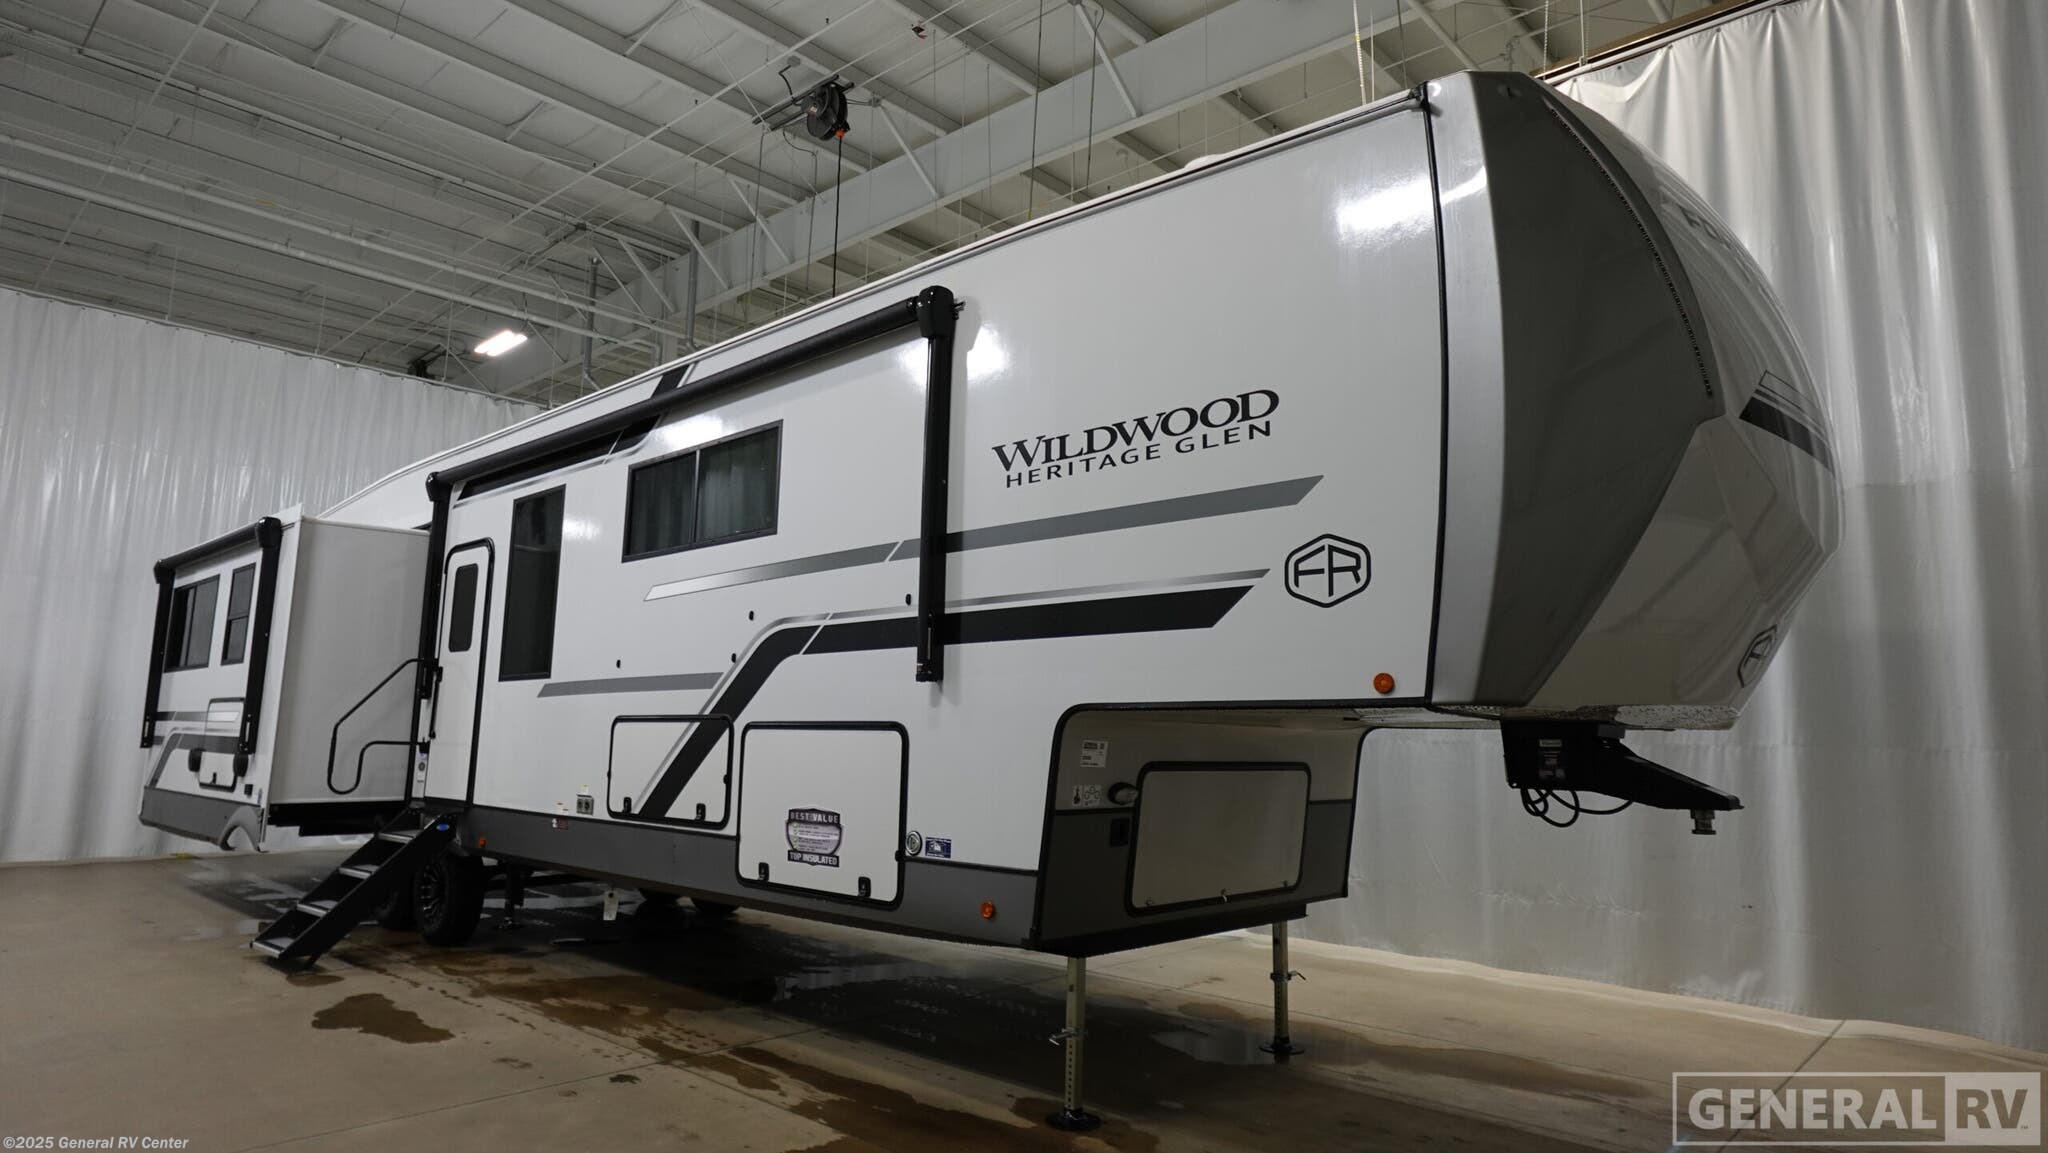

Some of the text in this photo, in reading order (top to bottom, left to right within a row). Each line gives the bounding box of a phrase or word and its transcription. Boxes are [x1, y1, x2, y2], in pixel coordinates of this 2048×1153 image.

[992, 389, 1280, 472] WILDWOOD
[1006, 420, 1271, 488] HERITAGE GLEN
[790, 811, 839, 824] BEST VALUE
